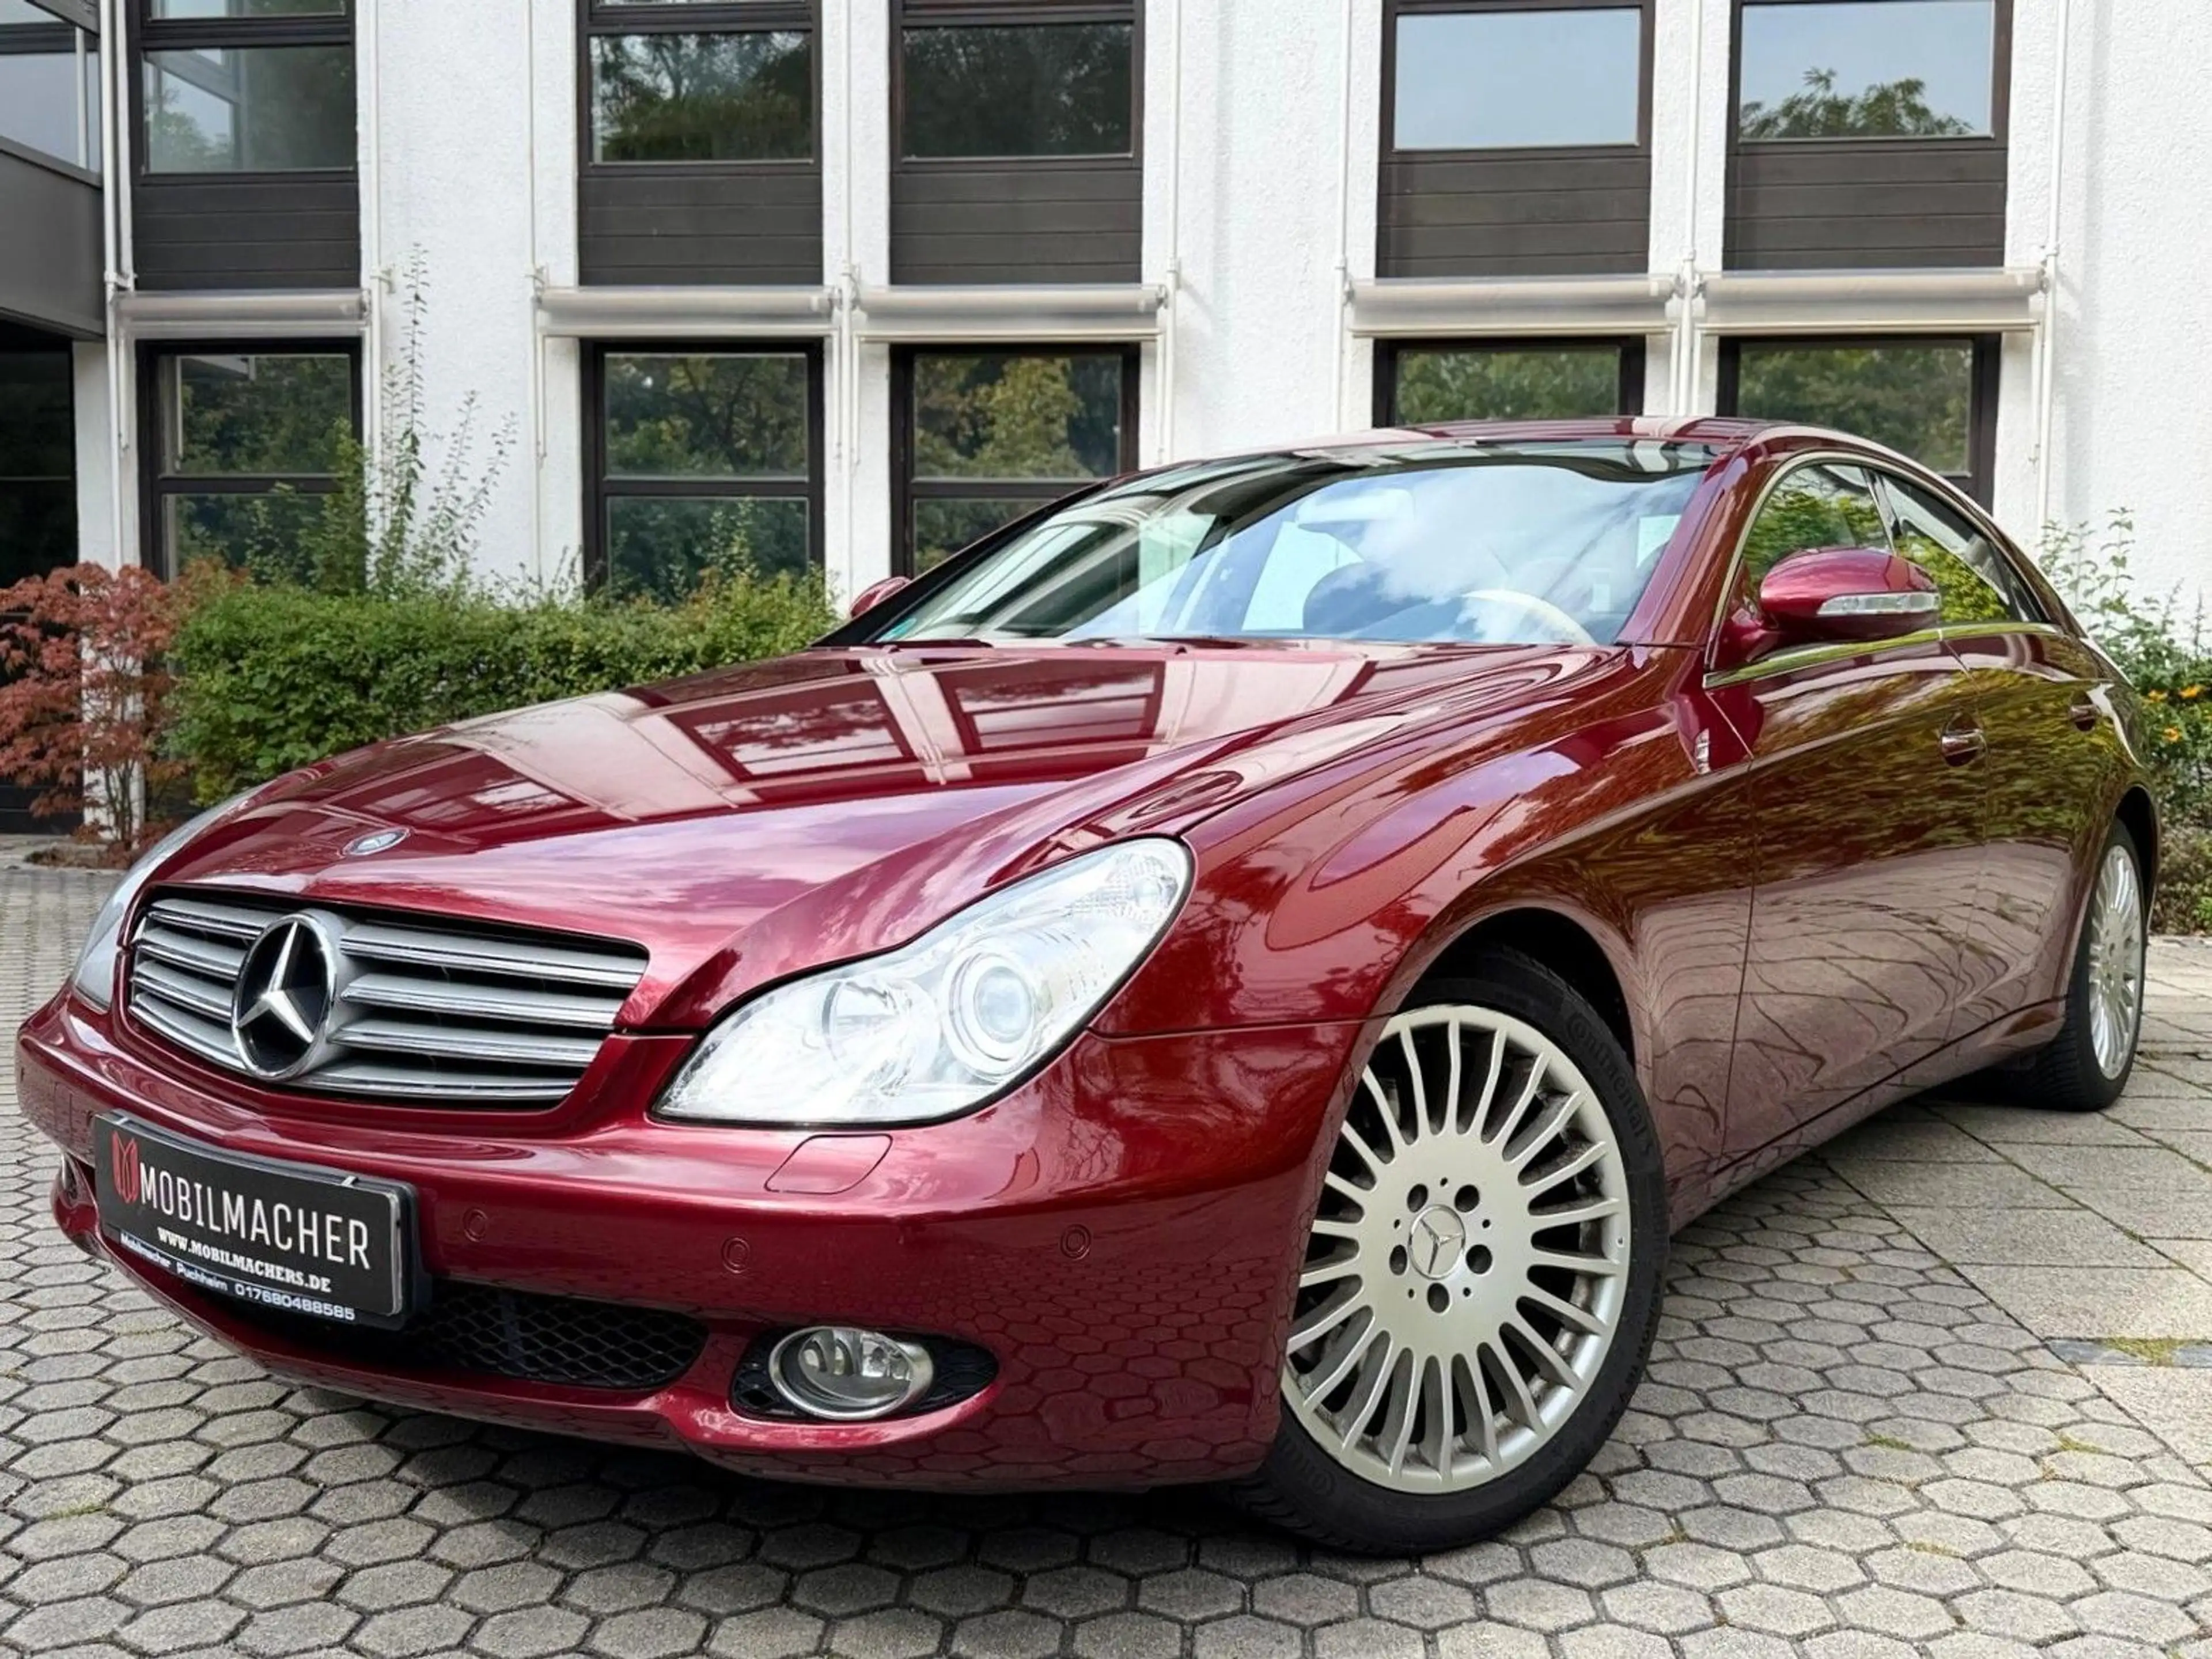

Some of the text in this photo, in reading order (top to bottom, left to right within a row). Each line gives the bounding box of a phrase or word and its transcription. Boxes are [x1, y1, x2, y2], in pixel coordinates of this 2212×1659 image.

[141, 1163, 370, 1269] MOBILMACHER
[157, 1227, 332, 1292] WWW.MOBILMACHERS.DE
[176, 1262, 228, 1291] Puchheim
